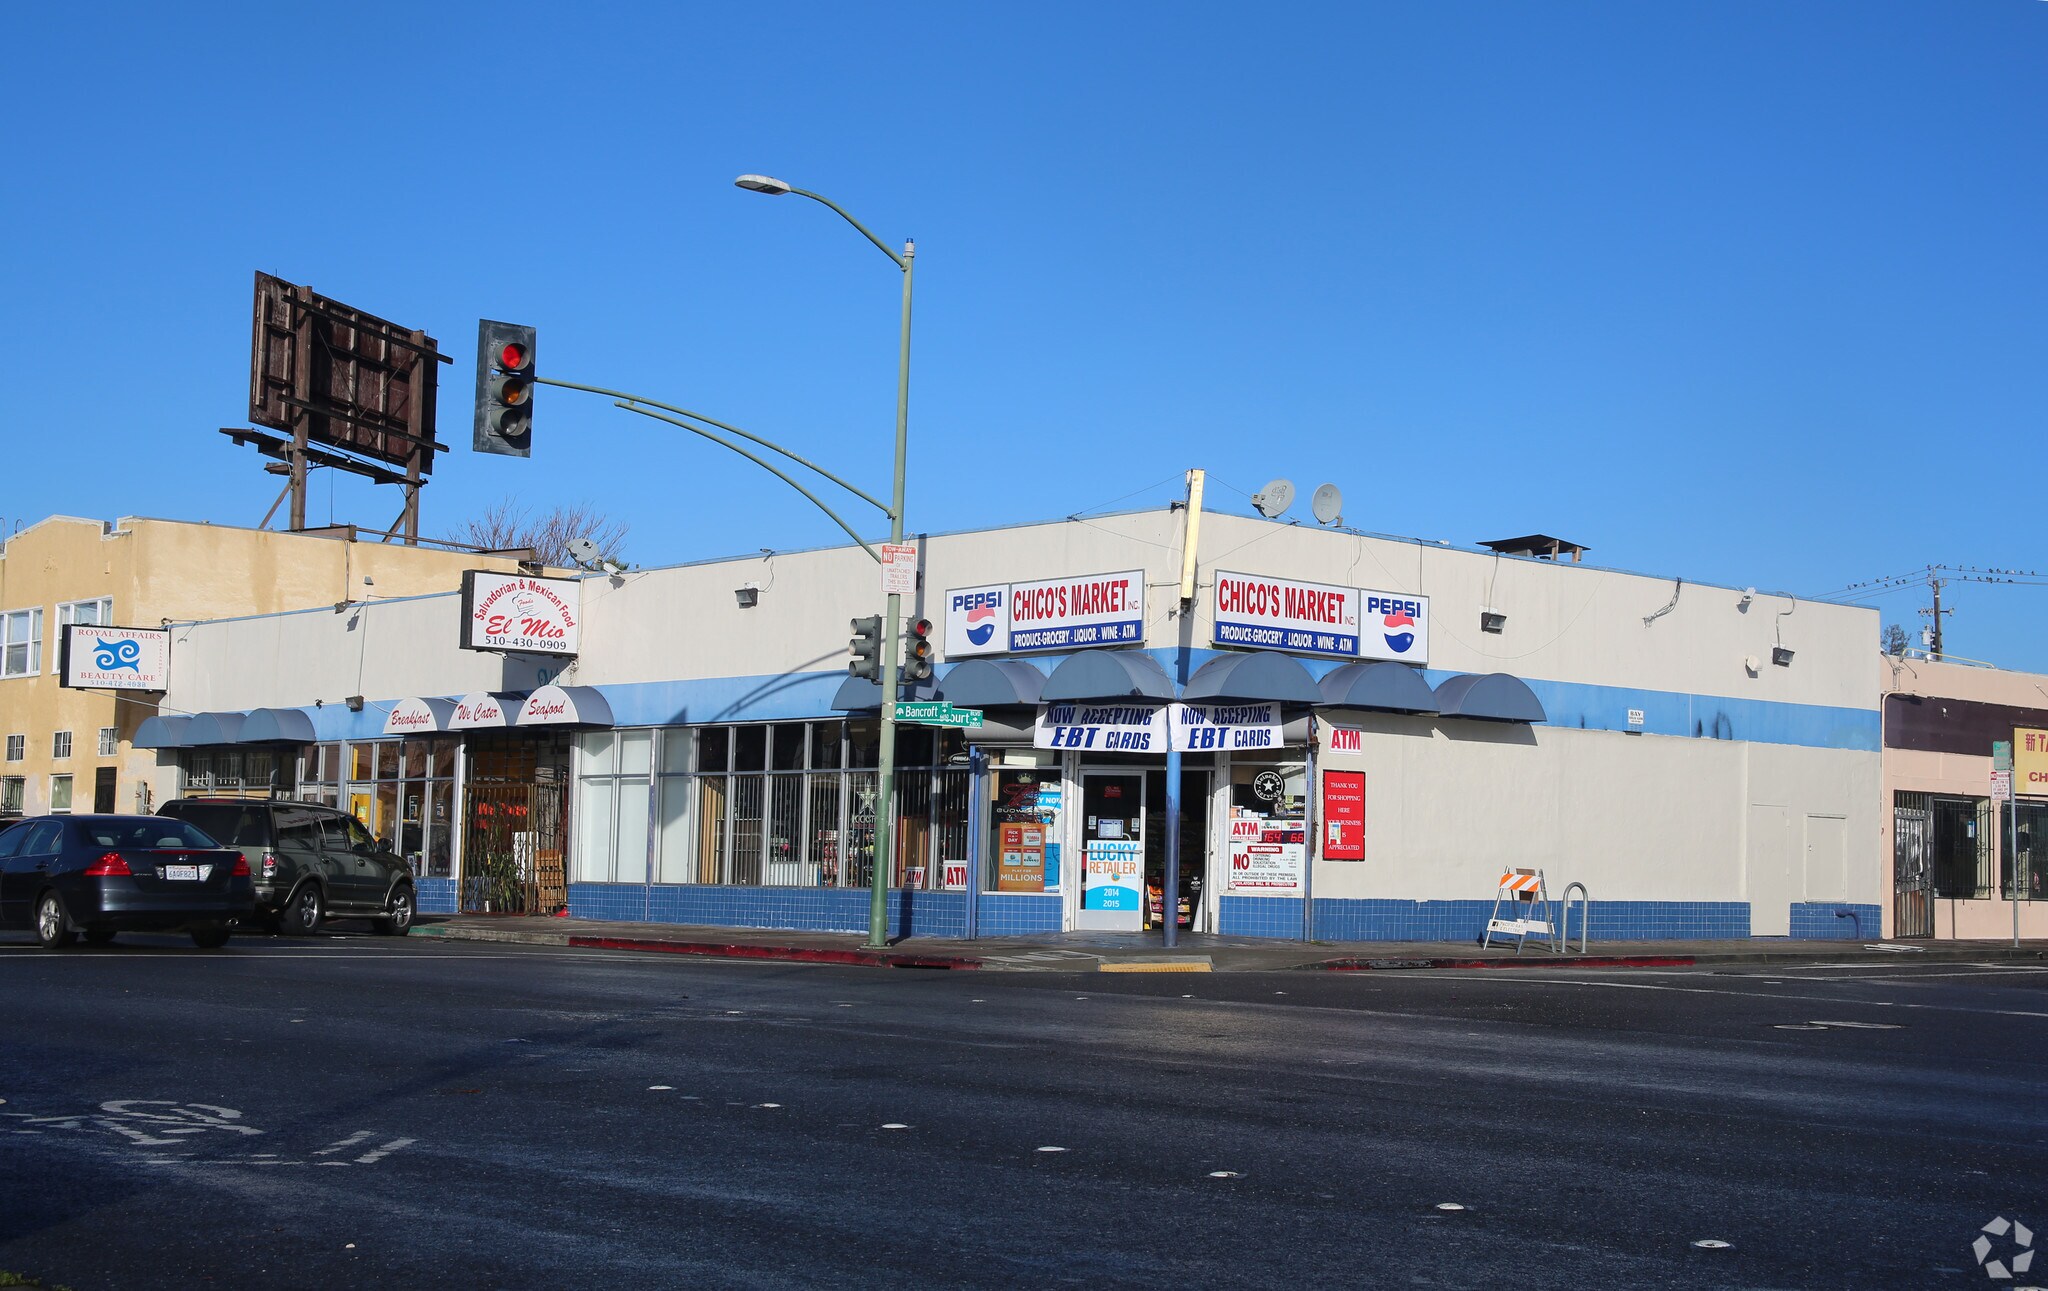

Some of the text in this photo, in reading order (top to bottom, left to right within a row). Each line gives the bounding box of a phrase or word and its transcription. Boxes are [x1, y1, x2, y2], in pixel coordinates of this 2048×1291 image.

[883, 552, 914, 562] NO PARKING
[474, 578, 577, 628] Salvadorian & Mexican Food
[952, 590, 1002, 612] PEPSI
[1013, 585, 1067, 622] CHICO'S
[1071, 579, 1129, 616] MARKET
[1218, 578, 1280, 618] CHICO'S
[1284, 587, 1345, 625] MARKET
[1367, 596, 1421, 619] PEPSI
[78, 628, 162, 639] ROYAL AFFAIRS
[485, 615, 565, 639] El Mio
[1014, 629, 1070, 648] PRODUCE-GROCERY
[1074, 628, 1097, 643] LIQUOR
[1101, 624, 1118, 641] WINE
[1122, 623, 1136, 639] ATM
[485, 635, 567, 650] 510-430-0909
[1220, 625, 1283, 646] PRODUCE-GROCERY
[1287, 632, 1313, 649] LIQUOR
[1317, 635, 1335, 651] WINE
[1338, 637, 1353, 652] ATM
[80, 671, 156, 682] BEAUTY CARE
[391, 709, 431, 729] Breakfast
[457, 702, 499, 722] We Cater
[528, 699, 565, 720] Seafood
[905, 706, 938, 718] Bancroft
[1047, 706, 1154, 726] NOW ACCEPTING
[1181, 706, 1271, 726] NOW ACCEPTING
[1051, 727, 1150, 750] EBT CARDS
[1188, 727, 1271, 749] EBT CARDS
[1331, 729, 1361, 750] ATM
[1337, 806, 1351, 814] HERE
[1232, 823, 1258, 835] ATM
[1340, 819, 1362, 827] BUSINESS
[1264, 833, 1281, 842] 164
[1290, 833, 1304, 842] 66
[1090, 843, 1137, 861] LUCKY
[1233, 853, 1250, 870] NO
[906, 871, 921, 882] ATM
[1090, 862, 1136, 874] RETAILER
[1104, 888, 1119, 897] 2014
[1103, 899, 1119, 908] 2015
